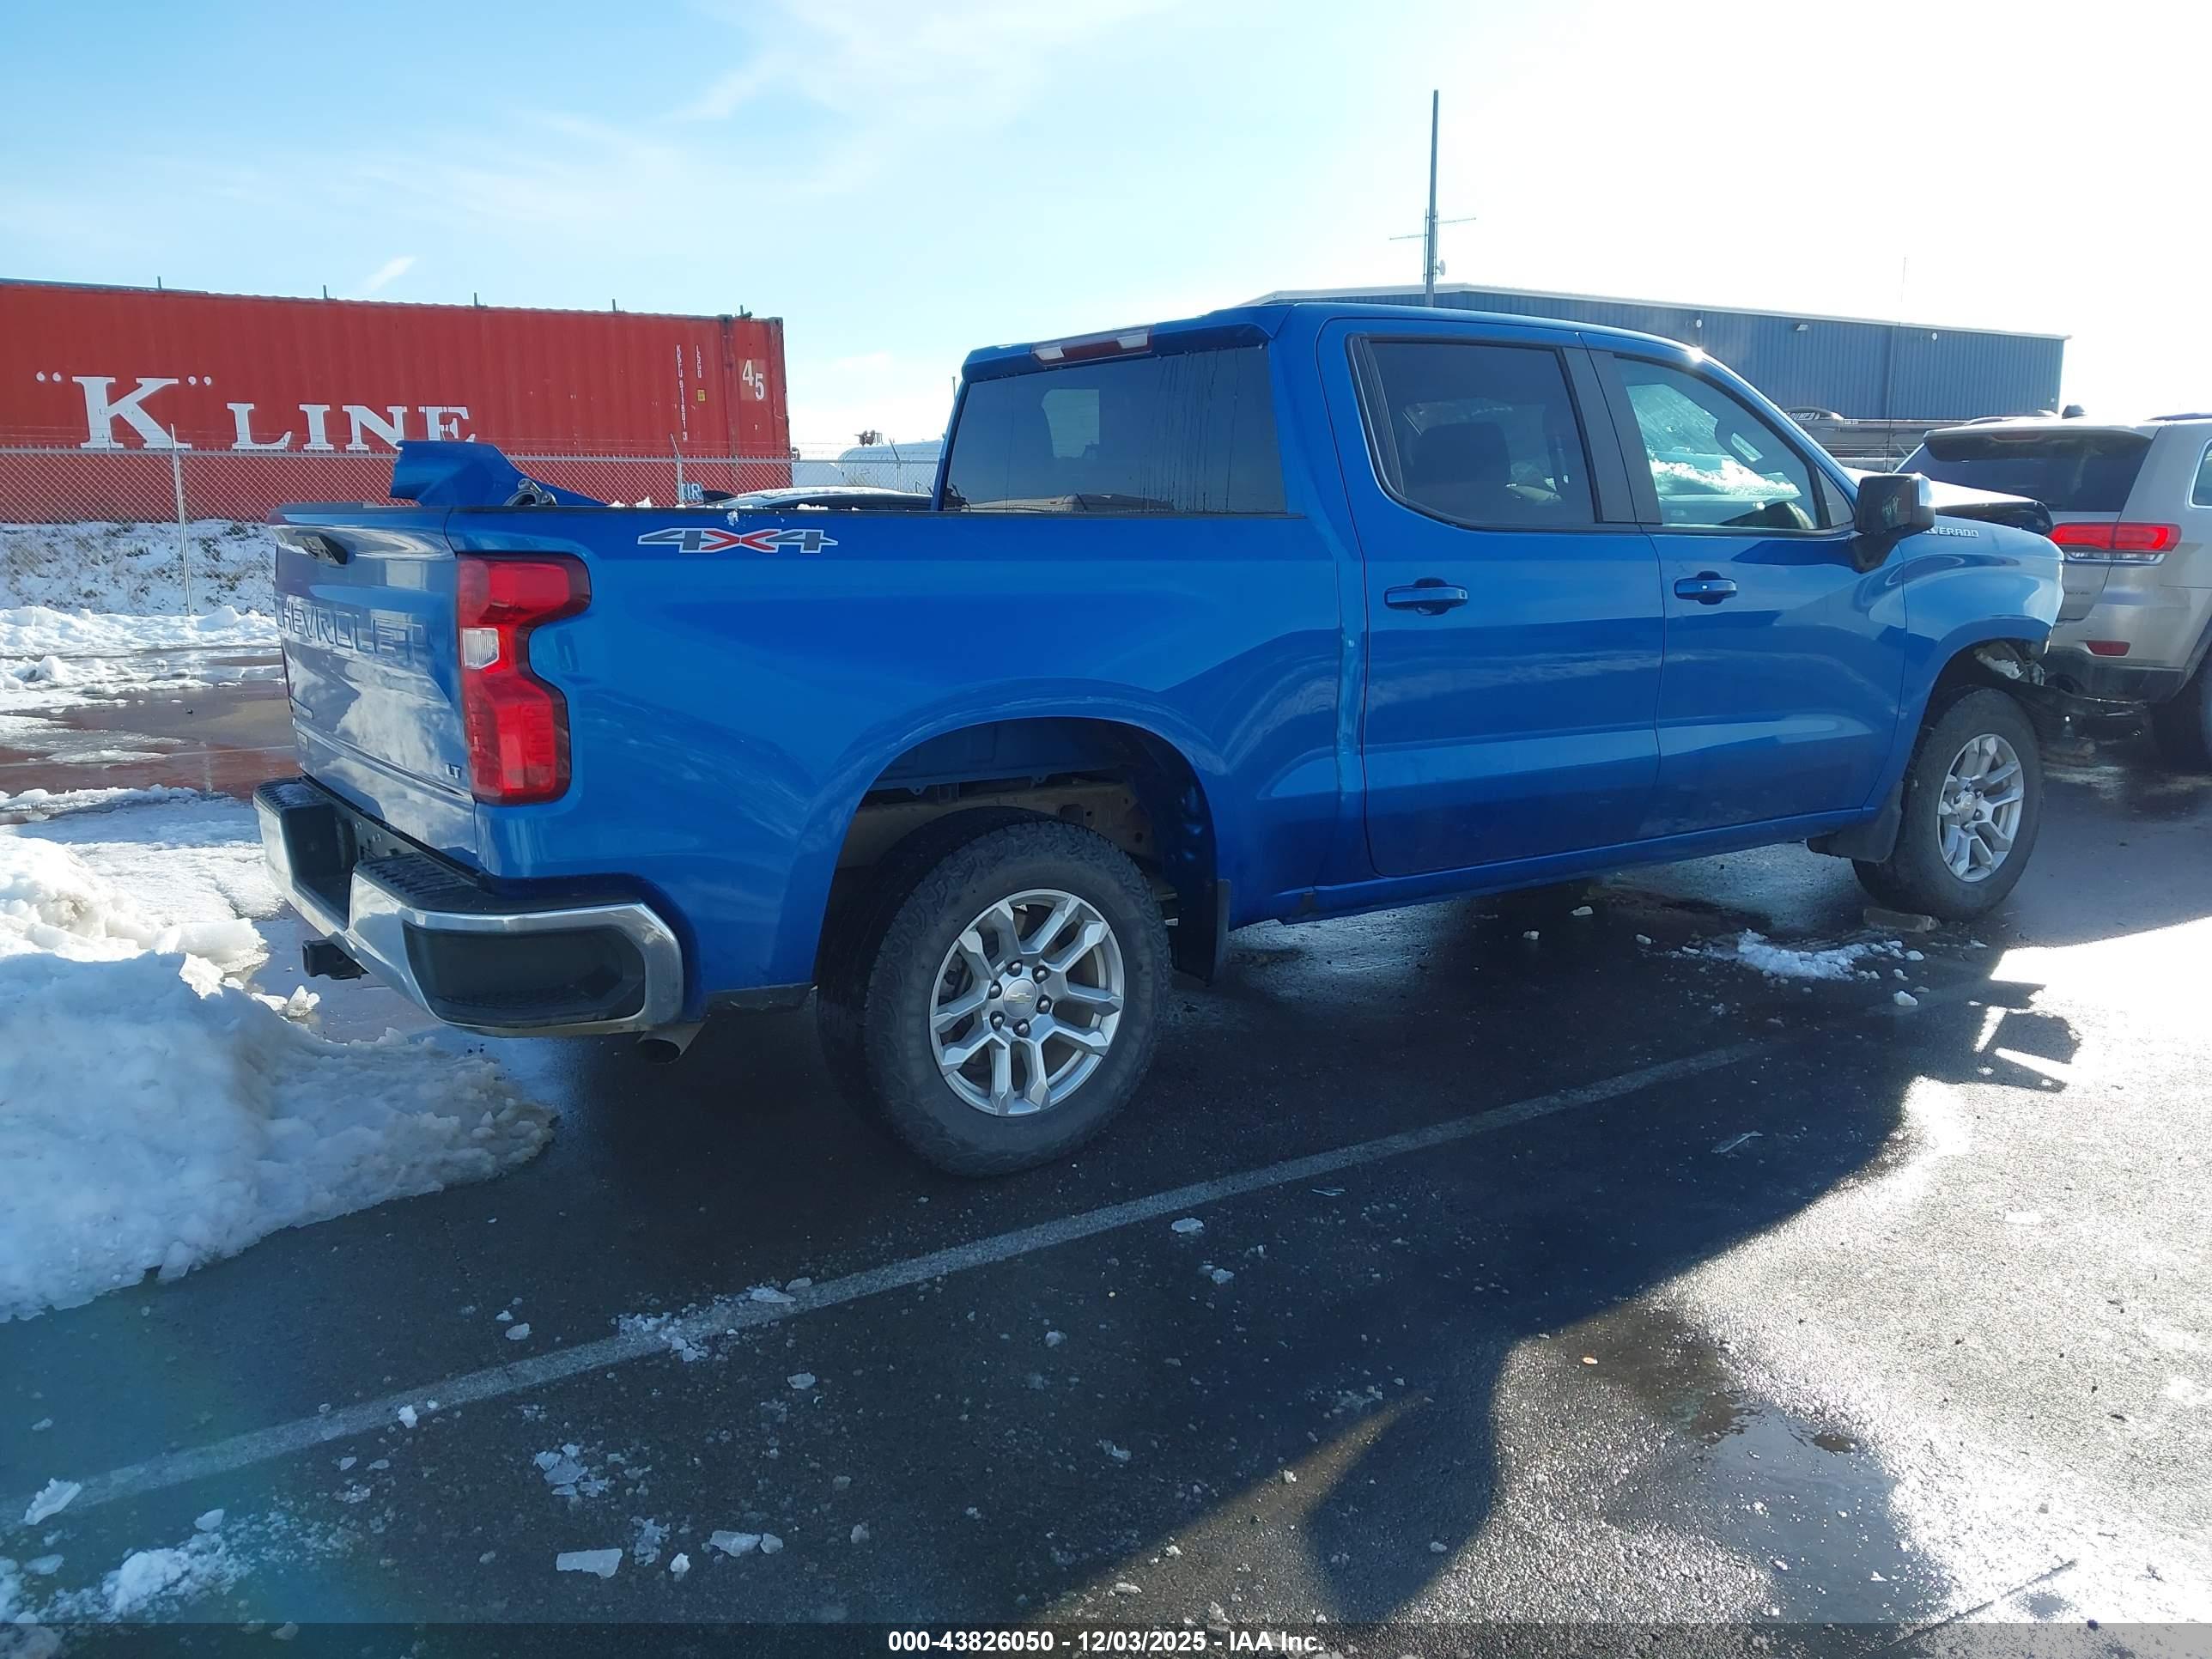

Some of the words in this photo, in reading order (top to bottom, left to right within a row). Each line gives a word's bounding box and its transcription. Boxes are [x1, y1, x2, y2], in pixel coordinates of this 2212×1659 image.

[742, 359, 764, 400] 45
[227, 403, 475, 451] LINE
[1922, 527, 1979, 538] LVERADO
[275, 596, 424, 662] CHEVROLET
[446, 763, 461, 778] LT
